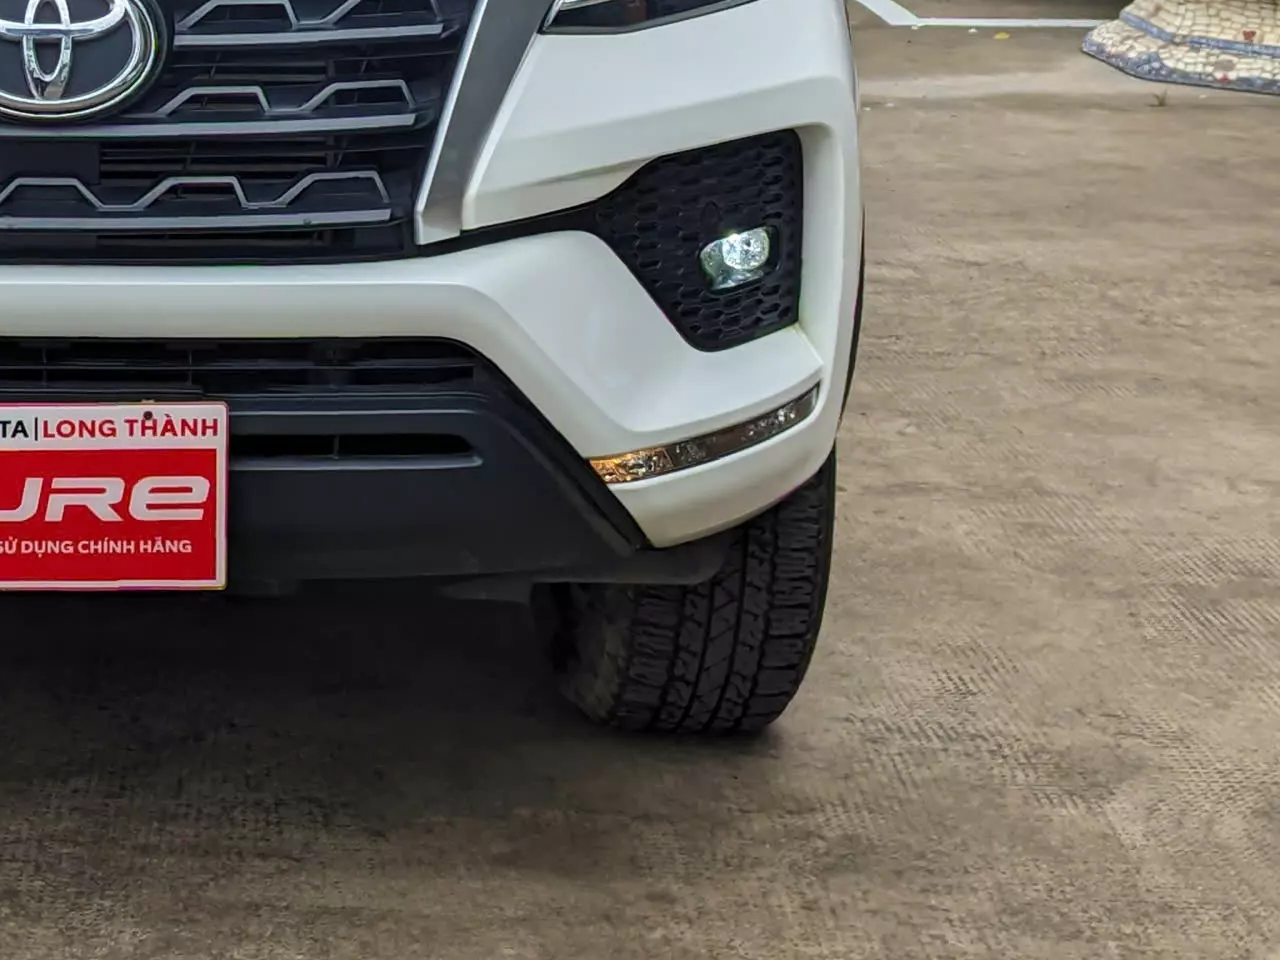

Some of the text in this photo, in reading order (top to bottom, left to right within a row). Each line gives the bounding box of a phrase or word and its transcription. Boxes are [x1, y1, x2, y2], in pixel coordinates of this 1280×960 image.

[43, 418, 117, 439] LONG
[124, 413, 218, 439] THÀNH
[21, 540, 74, 558] DỤNG
[77, 537, 135, 554] CHÍNH
